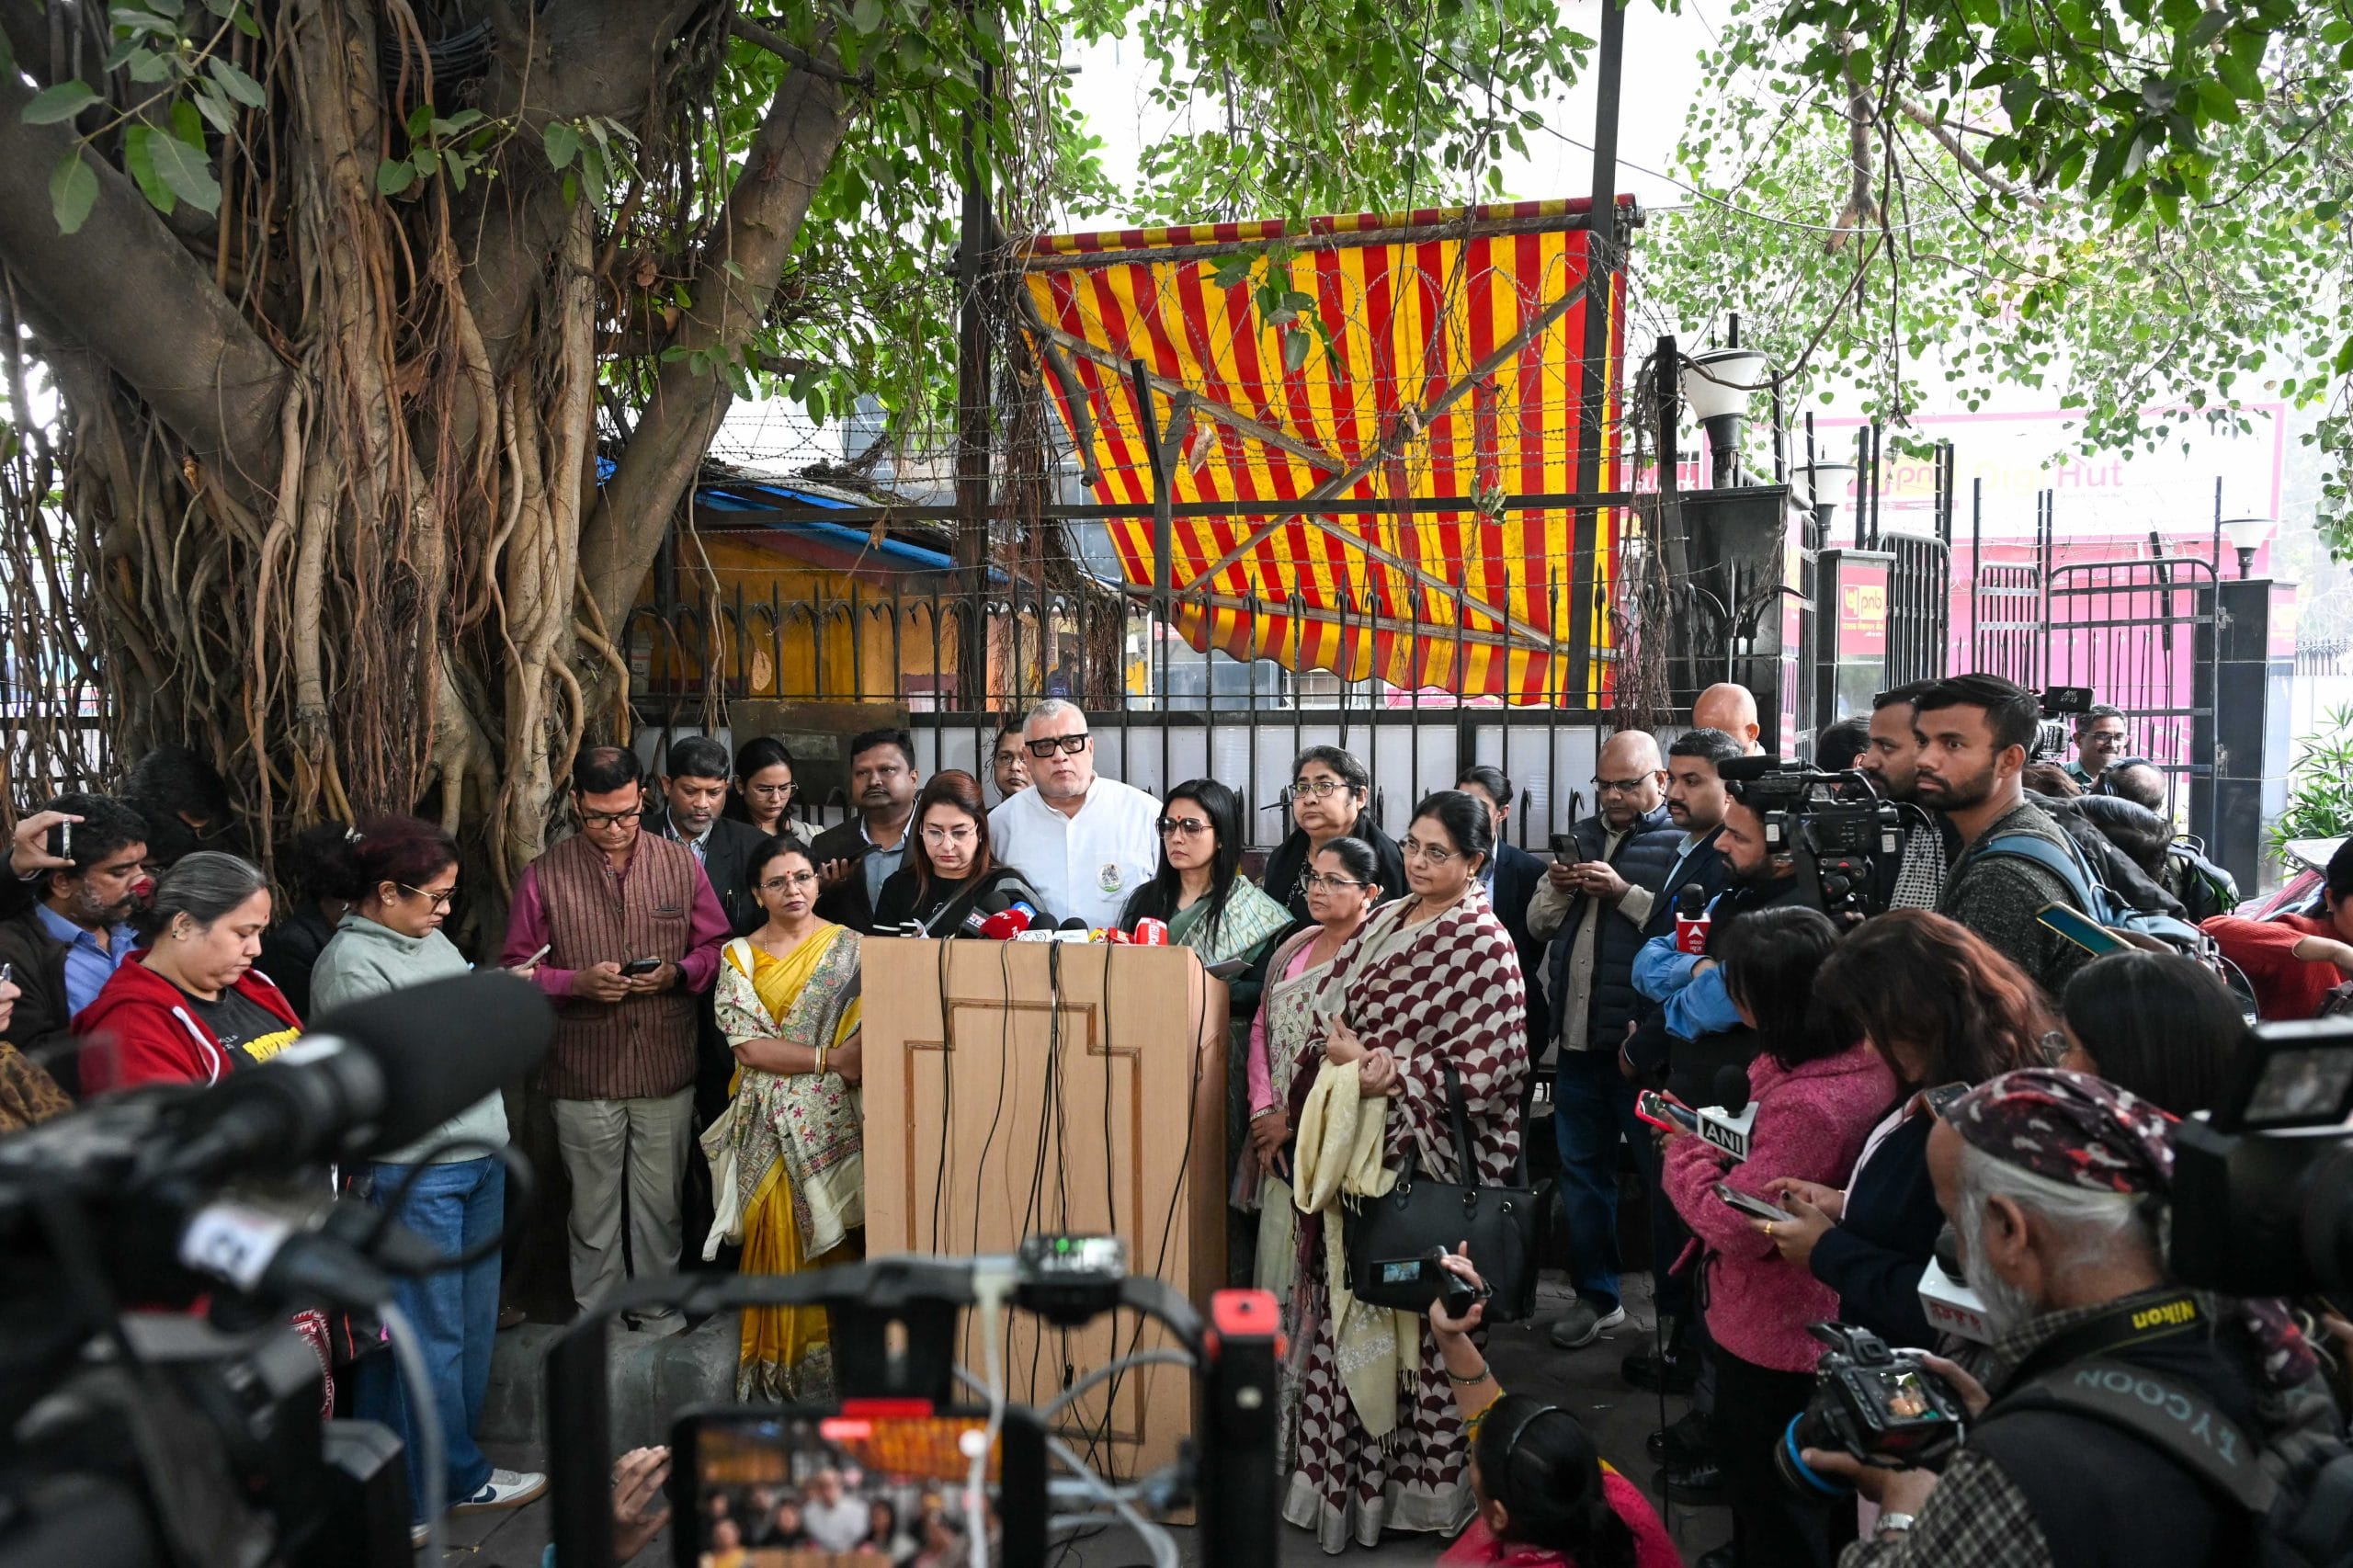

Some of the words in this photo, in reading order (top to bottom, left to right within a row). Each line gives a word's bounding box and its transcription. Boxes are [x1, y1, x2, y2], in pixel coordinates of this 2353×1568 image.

[2057, 460, 2123, 488] Hut
[1861, 589, 1882, 614] pnb
[1705, 1122, 1741, 1153] ANI
[2131, 1301, 2196, 1330] Nikon
[2074, 1369, 2237, 1467] TYCOON
